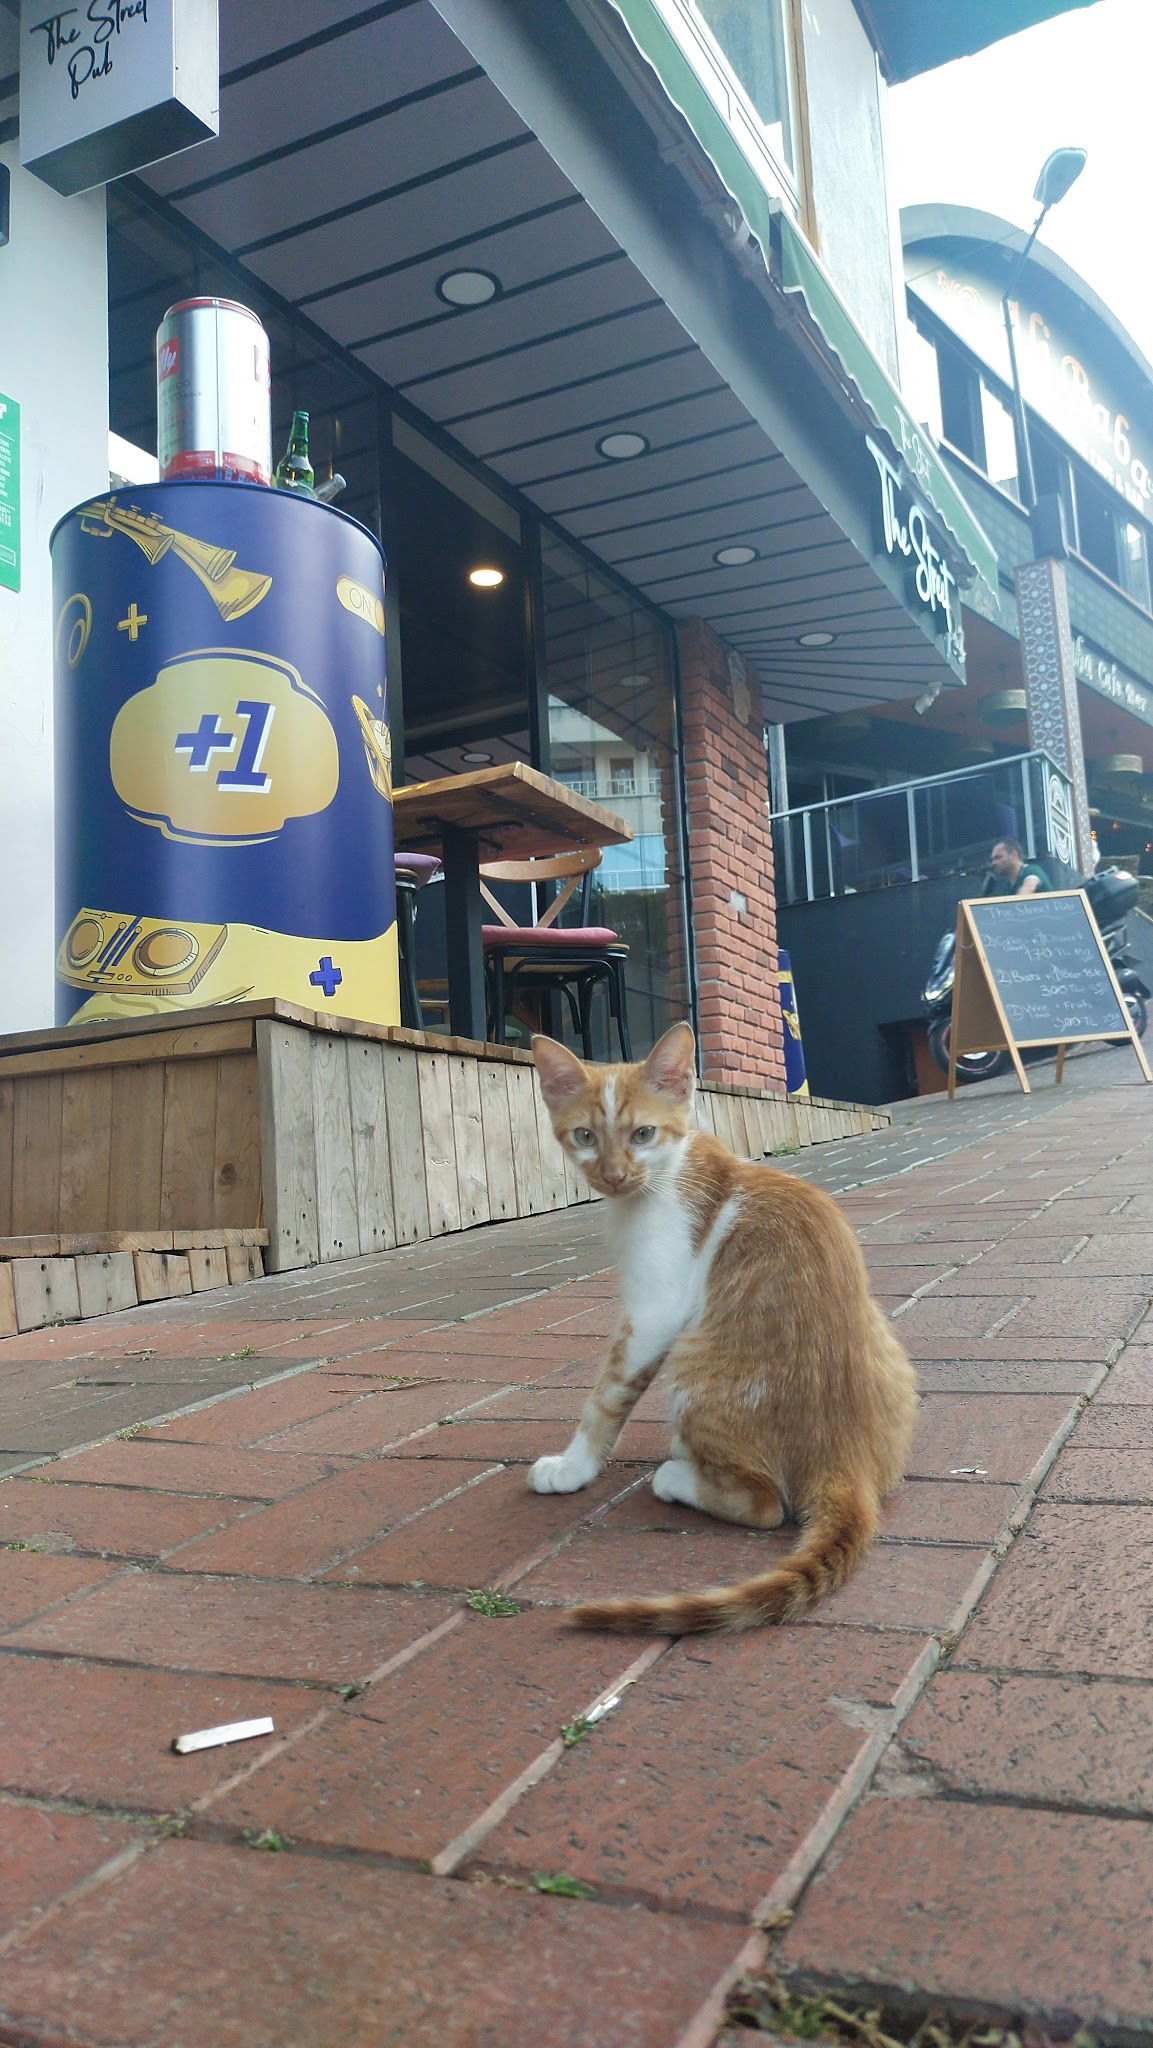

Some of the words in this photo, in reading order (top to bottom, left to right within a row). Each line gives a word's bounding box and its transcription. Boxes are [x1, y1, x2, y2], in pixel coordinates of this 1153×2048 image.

[29, 8, 81, 65] The
[86, 0, 147, 43] Street
[68, 41, 113, 100] Pub
[865, 434, 912, 557] The
[908, 504, 956, 633] Street
[349, 586, 372, 617] ON
[174, 699, 276, 794] +1
[984, 905, 1013, 920] The
